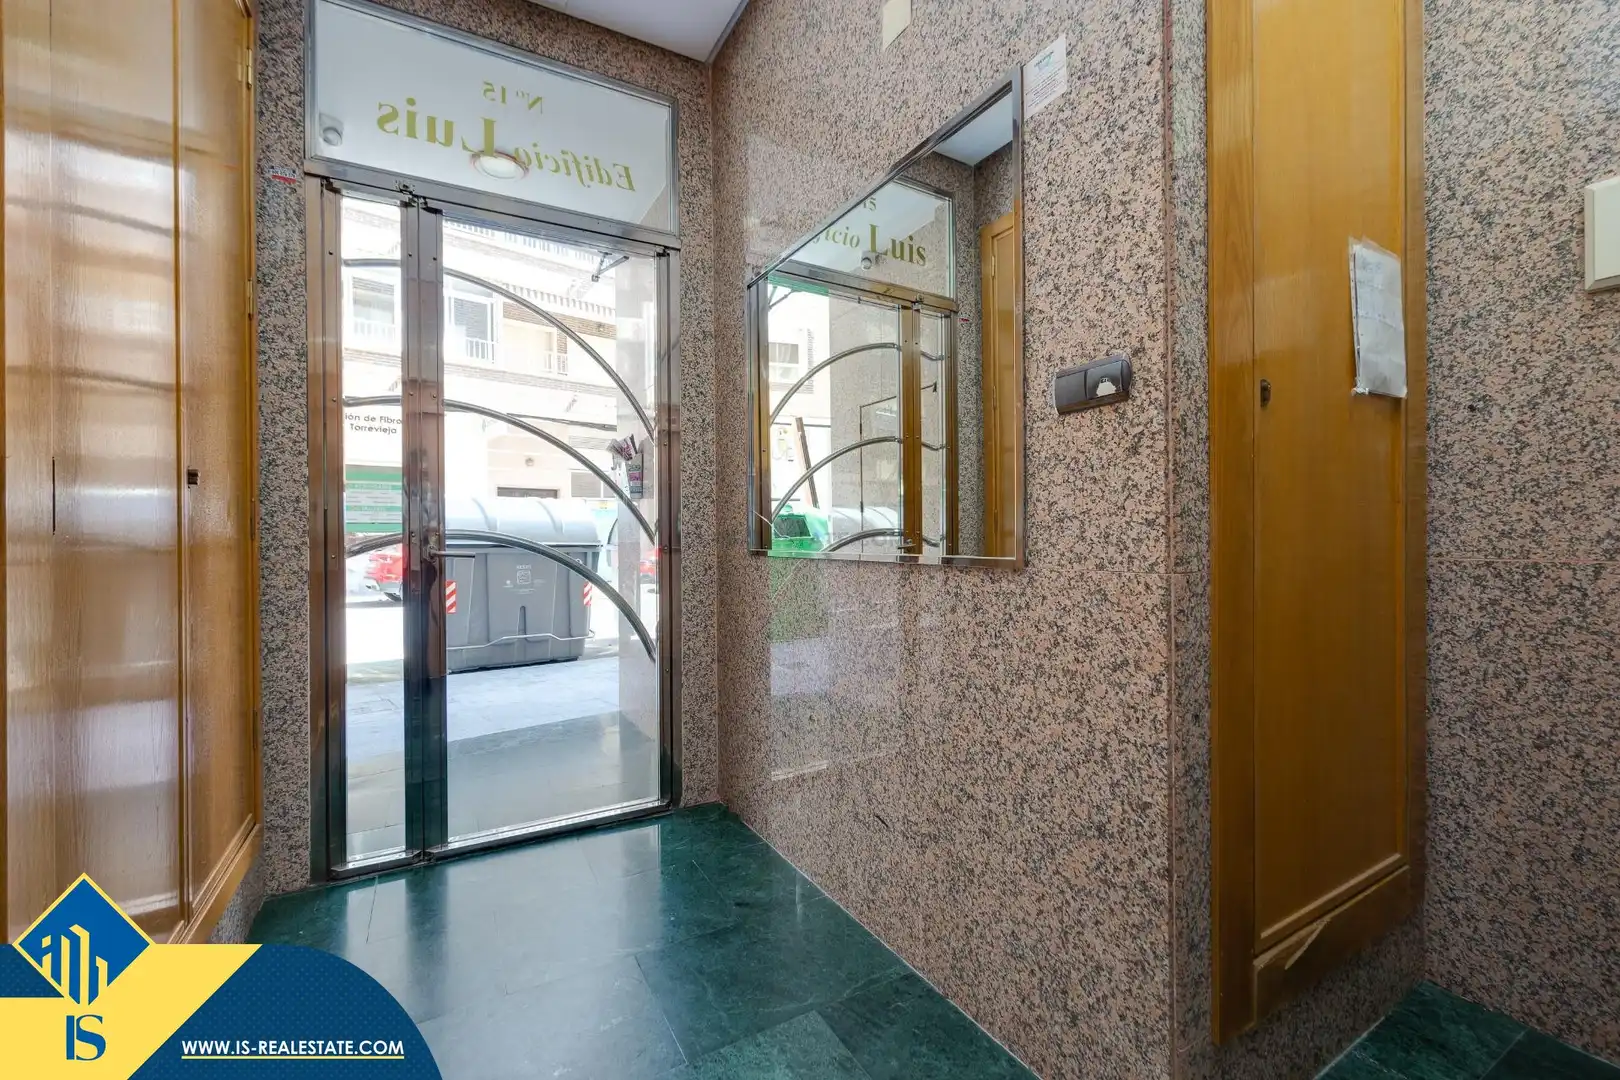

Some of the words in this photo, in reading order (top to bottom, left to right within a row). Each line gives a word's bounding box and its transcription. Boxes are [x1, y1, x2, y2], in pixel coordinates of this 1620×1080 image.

[812, 226, 861, 249] icio
[869, 223, 926, 267] Luis
[350, 423, 397, 435] Torrevieja
